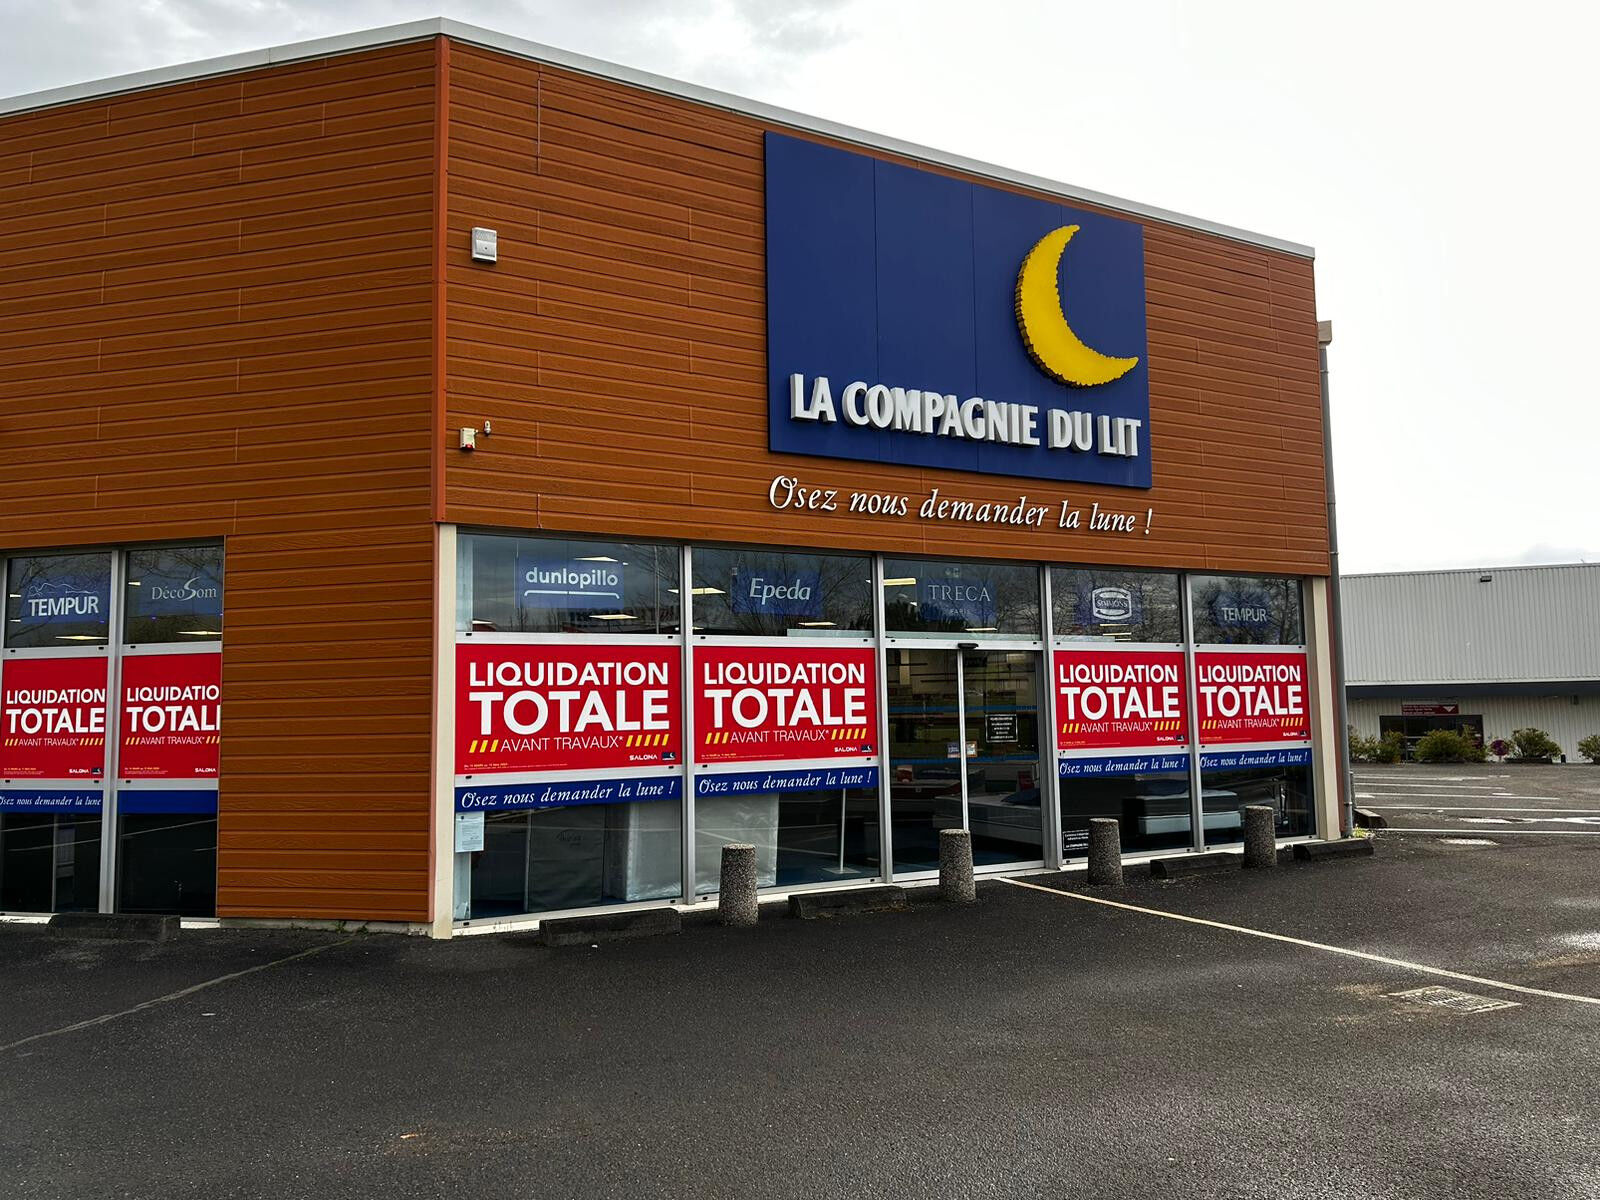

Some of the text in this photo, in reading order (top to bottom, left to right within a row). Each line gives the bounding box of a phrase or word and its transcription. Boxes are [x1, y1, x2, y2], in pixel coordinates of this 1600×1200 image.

[790, 373, 1141, 457] LA COMPAGNIE DU LIT
[850, 492, 909, 516] nous
[920, 488, 1048, 526] demander
[1059, 500, 1080, 529] la
[1089, 502, 1135, 532] lune
[1145, 508, 1153, 535] !
[526, 567, 618, 589] dunlopillo
[152, 576, 217, 601] DécoSom
[749, 578, 811, 605] Epeda
[928, 585, 991, 601] TRECA
[28, 596, 99, 617] TEMPUR
[1221, 607, 1267, 622] TEMPUR
[469, 661, 668, 687] LIQUIDATION
[704, 662, 865, 685] LIQUIDATION
[1060, 664, 1178, 683] LIQUIDATION
[1199, 665, 1301, 683] LIQUIDATION
[7, 688, 105, 704] LIQUIDATION
[127, 685, 219, 702] LIQUIDATIO
[1060, 686, 1180, 720] TOTALE
[1200, 685, 1303, 717] TOTALE
[469, 690, 670, 735] TOTALE
[704, 688, 867, 728] TOTALE
[6, 708, 105, 734] TOTALE
[1081, 722, 1109, 733] AVANT
[1217, 719, 1242, 729] AVANT
[19, 738, 42, 746] AVANT
[140, 736, 165, 745] AVANT
[500, 737, 550, 752] AVANT
[730, 731, 770, 743] AVANT
[1083, 763, 1102, 773] nous
[1105, 759, 1148, 772] demander
[1151, 758, 1159, 769] la
[1161, 758, 1178, 769] lune
[1181, 758, 1185, 768] !
[1220, 757, 1237, 766] nous
[1239, 753, 1275, 766] demander
[1278, 752, 1286, 763] la
[1288, 751, 1302, 763] lune
[732, 780, 758, 791] nous
[762, 773, 821, 789] demander
[825, 772, 836, 785] la
[840, 771, 863, 784] lune
[867, 770, 872, 783] !
[35, 796, 72, 806] demander
[75, 796, 82, 806] la
[84, 796, 101, 806] lune
[503, 793, 535, 805] nous
[540, 783, 613, 802] demander
[618, 783, 631, 797] la
[636, 782, 664, 797] lune
[668, 780, 674, 794] !
